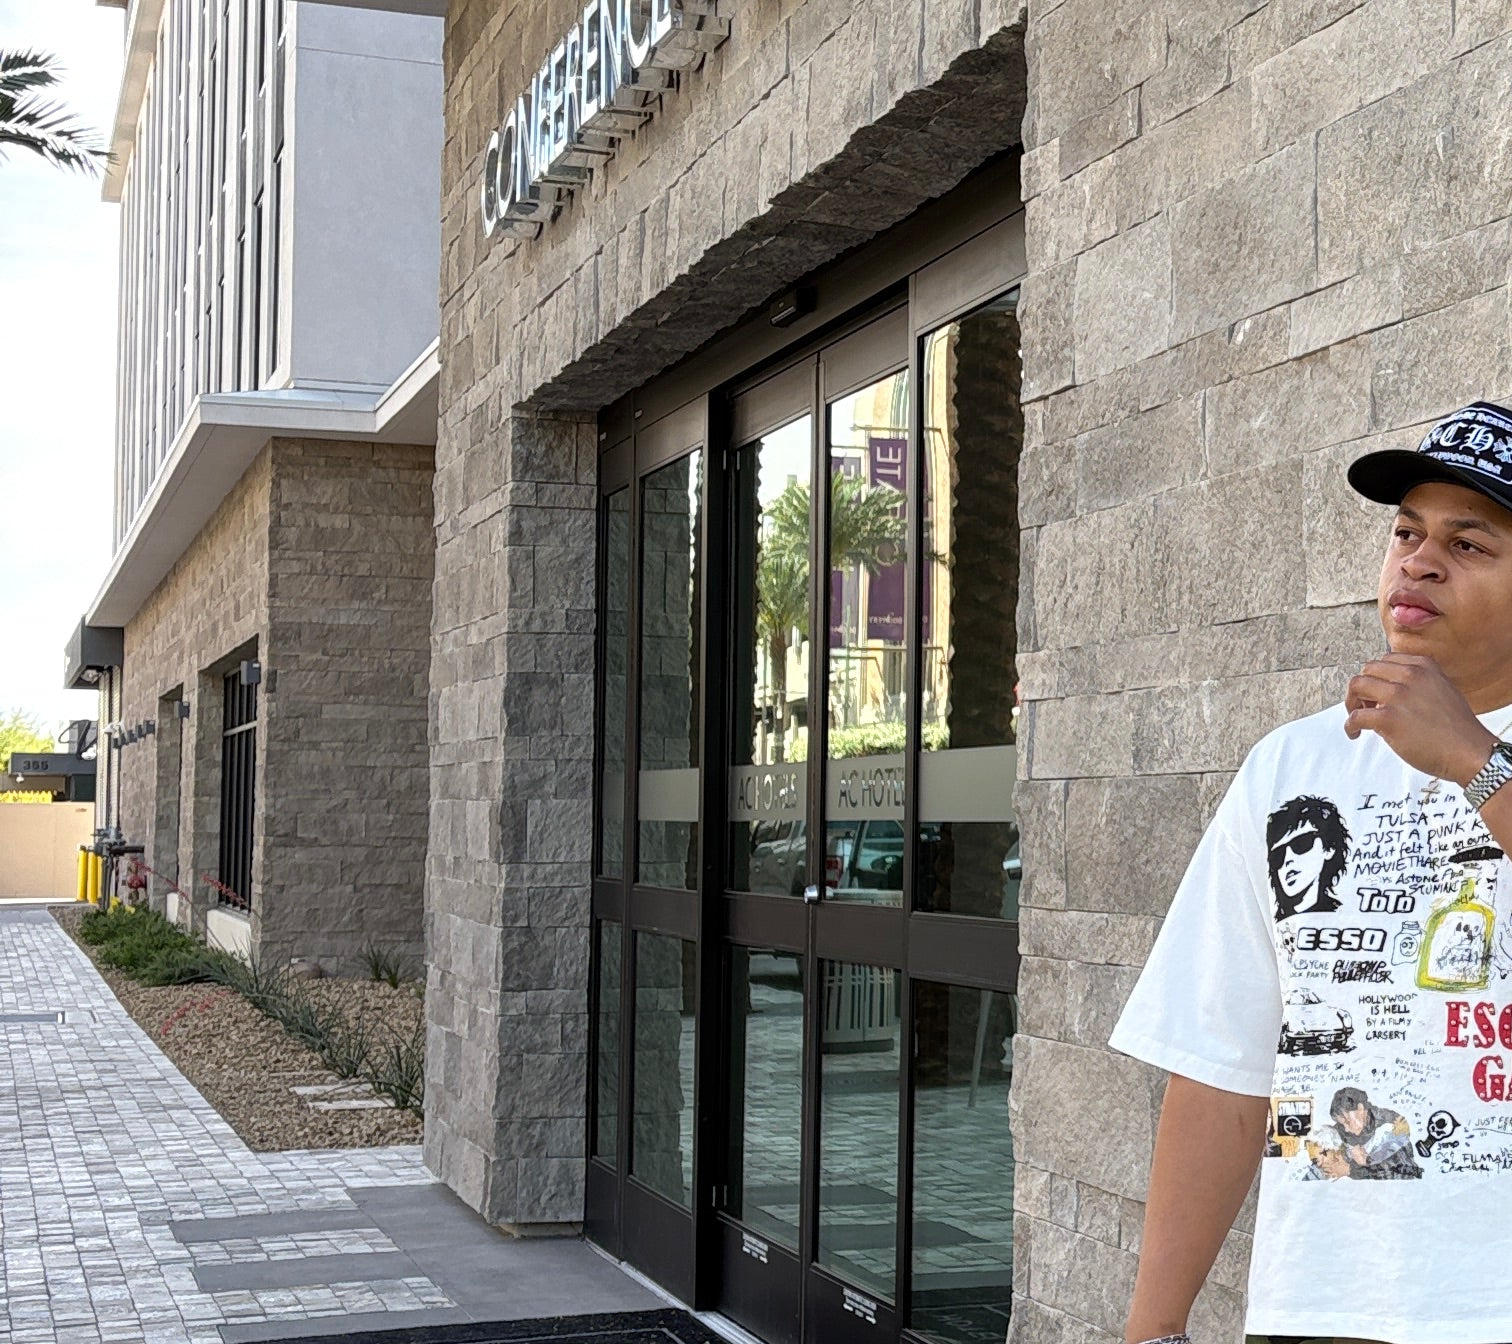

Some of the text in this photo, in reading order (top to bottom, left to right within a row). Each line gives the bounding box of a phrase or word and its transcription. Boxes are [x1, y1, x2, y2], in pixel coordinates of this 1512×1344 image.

[838, 769, 858, 808] AC
[1356, 793, 1378, 810] I
[1381, 791, 1412, 809] met
[1375, 812, 1428, 828] TULSA
[1362, 829, 1404, 846] JUST
[1408, 828, 1420, 840] A
[1427, 820, 1467, 845] PUNK
[1352, 845, 1383, 862] And
[1385, 846, 1396, 857] it
[1399, 842, 1424, 859] felt
[1297, 927, 1387, 952] ESSO
[1370, 1005, 1410, 1015] IS HELL
